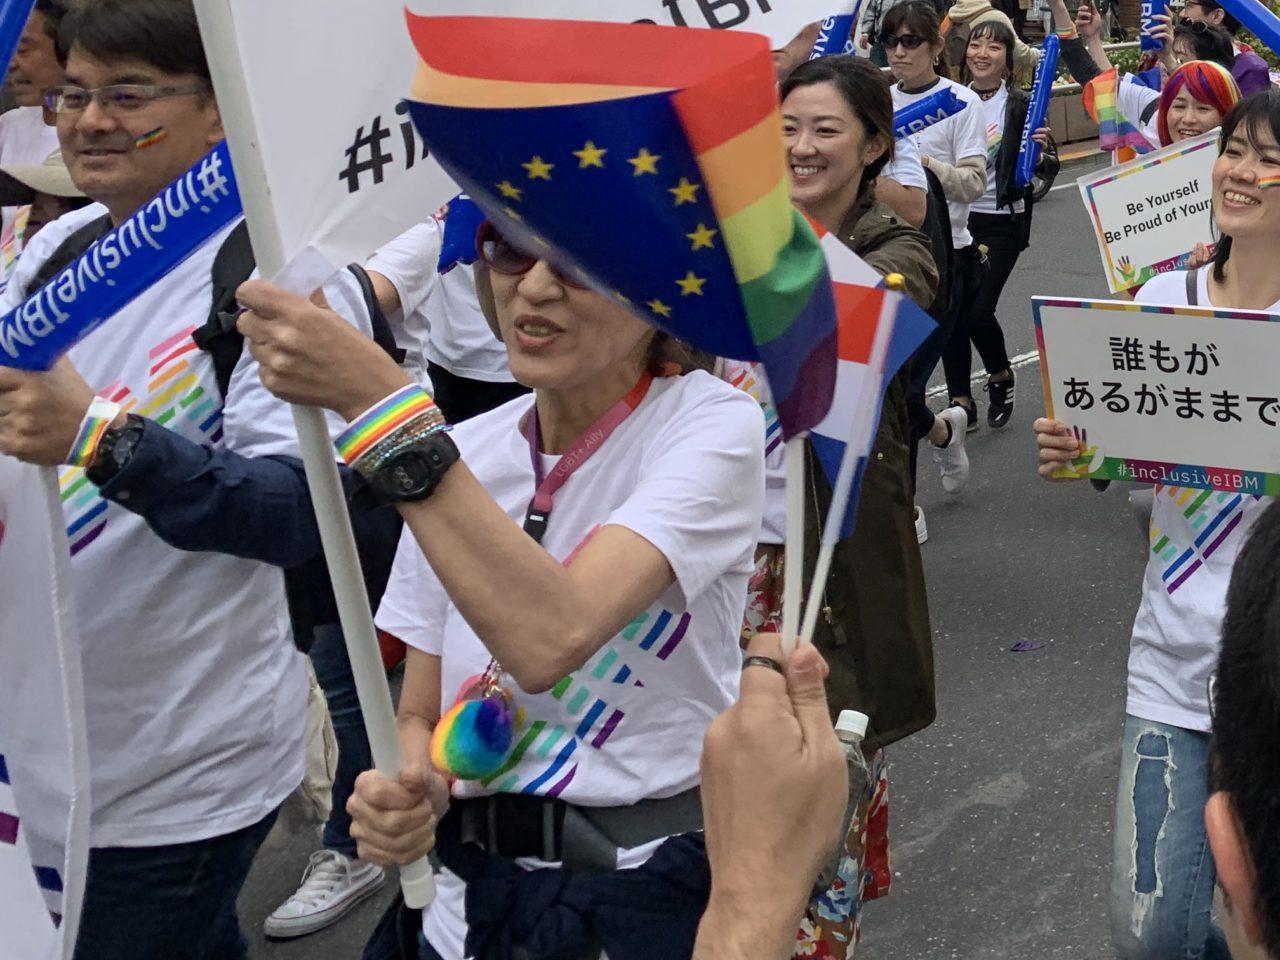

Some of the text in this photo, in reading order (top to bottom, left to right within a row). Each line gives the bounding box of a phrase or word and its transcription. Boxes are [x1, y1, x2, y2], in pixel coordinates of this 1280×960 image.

[1126, 179, 1200, 216] Be Yourself
[1104, 231, 1122, 244] Be
[1123, 213, 1163, 238] Proud
[1165, 210, 1178, 223] of
[0, 151, 230, 359] #inclusiveIBM
[1109, 336, 1220, 376] 誰もが
[584, 429, 604, 448] Ally
[1117, 463, 1259, 490] #inclusiveIBM
